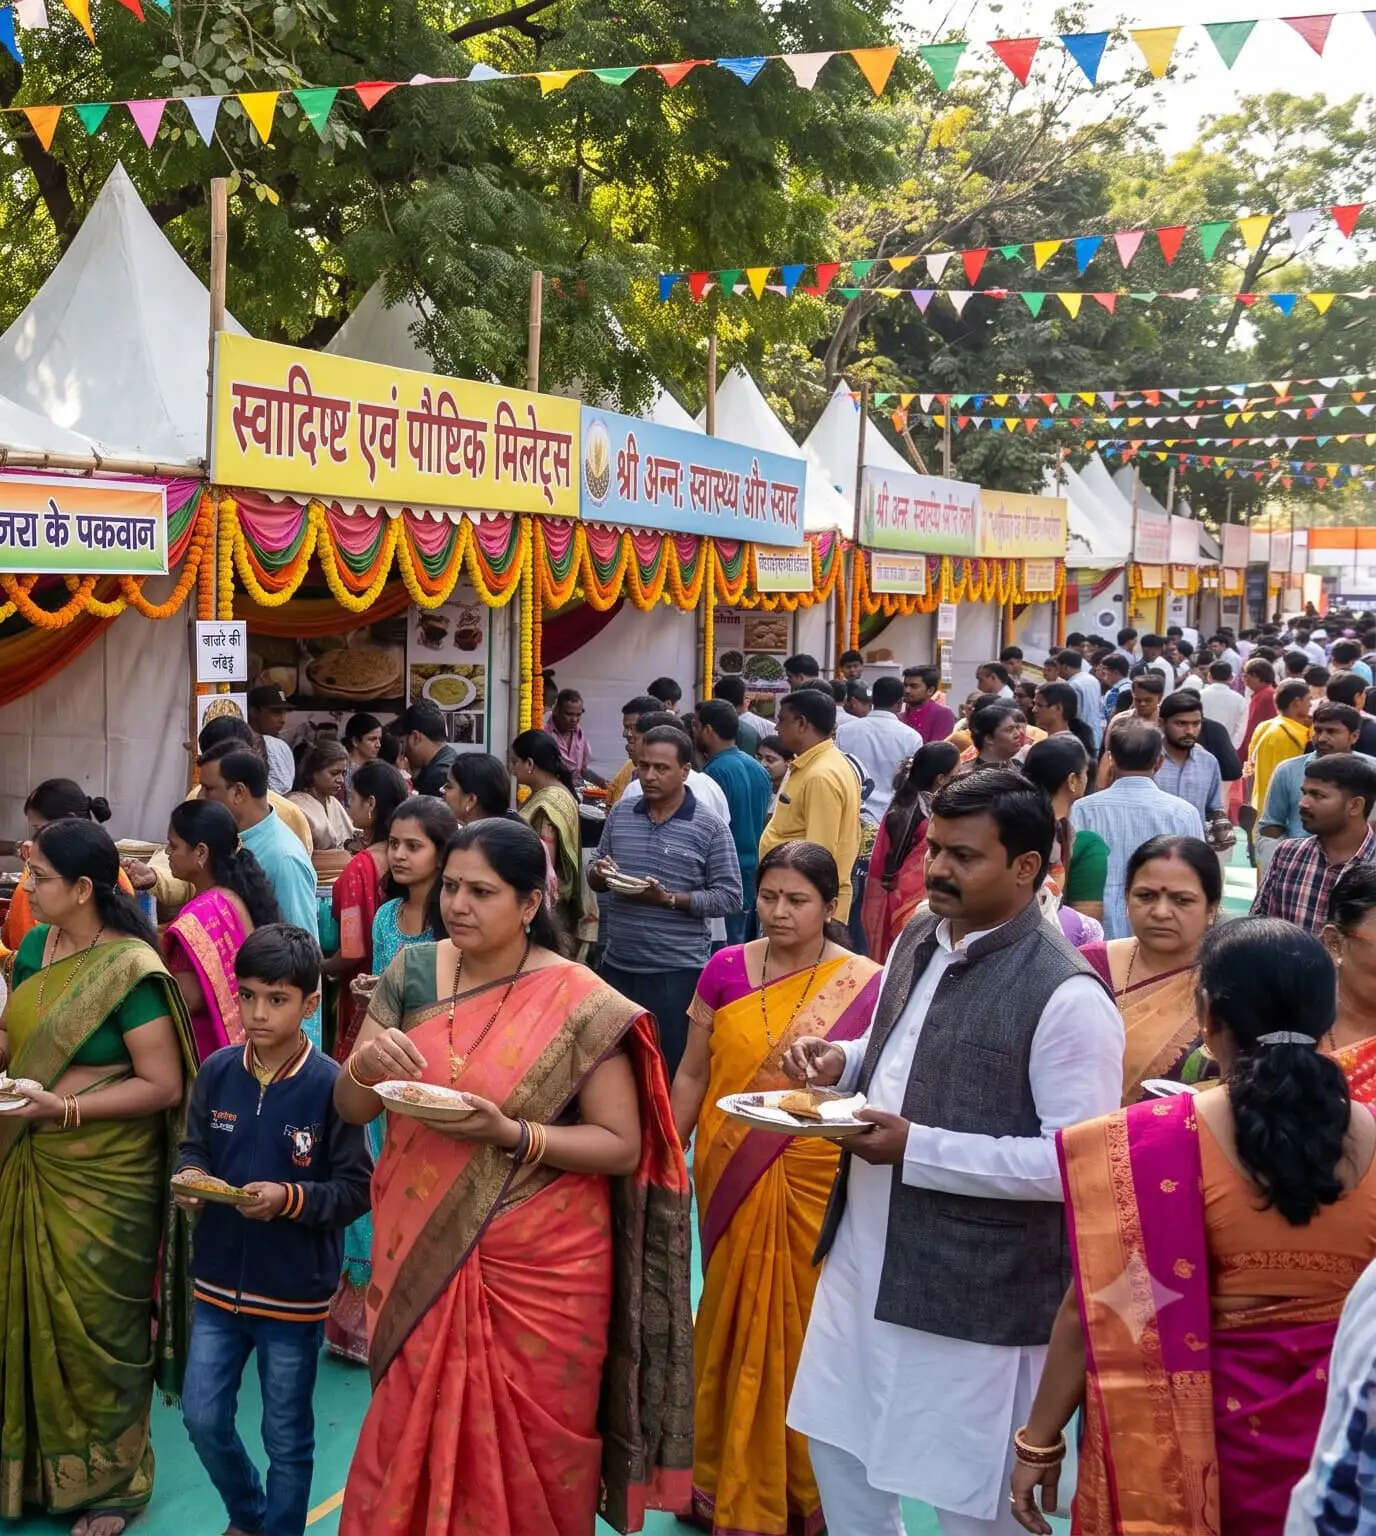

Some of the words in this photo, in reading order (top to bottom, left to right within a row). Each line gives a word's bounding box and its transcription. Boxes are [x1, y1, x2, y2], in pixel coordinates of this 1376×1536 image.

[358, 385, 399, 483] एवं
[406, 387, 488, 478] पौष्टिक
[494, 401, 572, 506] मिलेट्स
[617, 432, 640, 501] श्री
[689, 464, 740, 516] स्वास्थ्य
[743, 458, 767, 521] और
[771, 482, 799, 530] स्वाद
[44, 499, 70, 548] के
[76, 515, 156, 550] पकवान
[228, 628, 241, 647] की
